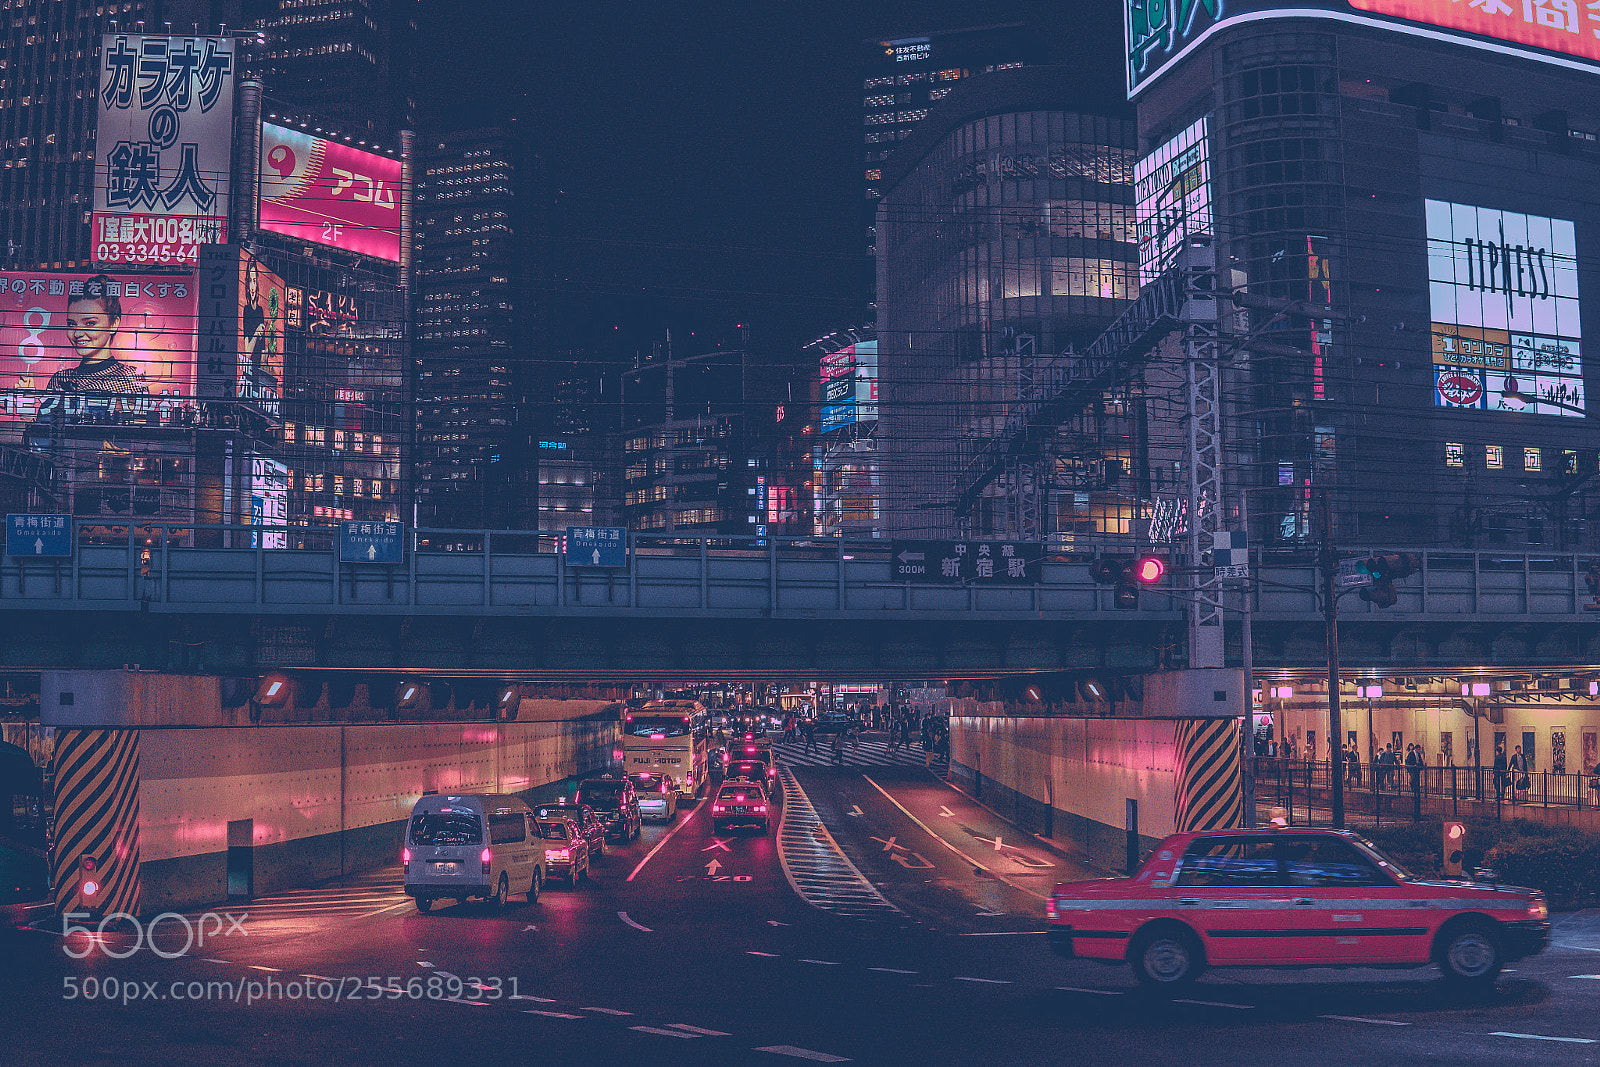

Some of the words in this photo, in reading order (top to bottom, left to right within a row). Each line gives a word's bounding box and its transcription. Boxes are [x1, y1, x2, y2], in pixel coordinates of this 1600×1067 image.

[101, 36, 233, 112] カラオケ
[147, 103, 180, 149] の
[106, 141, 215, 212] 鉄人
[332, 167, 394, 210] アコム
[321, 221, 344, 242] 2F
[208, 251, 231, 260] THE
[1465, 218, 1548, 319] TIPNESS
[1461, 340, 1505, 357] ワンカラ
[14, 516, 65, 528] 青梅街道
[348, 523, 397, 536] 青梅街道
[573, 528, 620, 540] 青梅街道
[955, 543, 1015, 557] 中央線
[898, 565, 925, 574] 300M
[941, 557, 1026, 578] 新宿駅
[1214, 566, 1248, 578] 時差式
